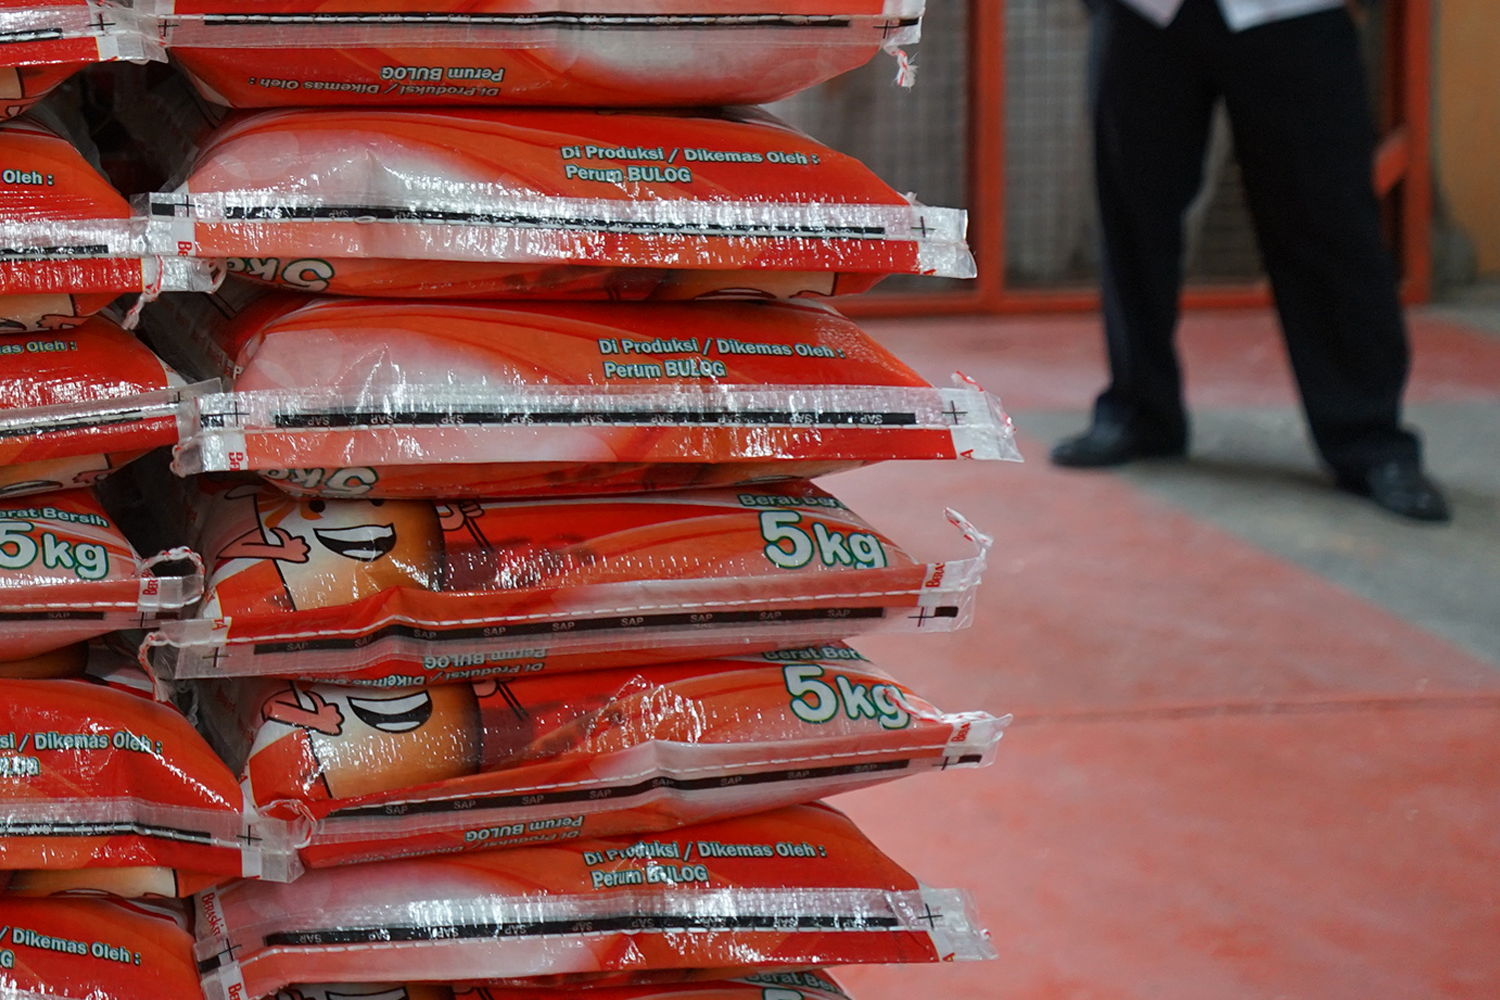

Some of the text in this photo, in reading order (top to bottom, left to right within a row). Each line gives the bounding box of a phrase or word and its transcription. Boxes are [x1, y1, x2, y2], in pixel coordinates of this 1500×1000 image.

[381, 67, 505, 80] Perum BULOG
[561, 146, 582, 159] Di
[586, 146, 664, 161] Produksi
[684, 148, 763, 164] Dikemas
[766, 151, 808, 165] Oleh
[566, 165, 692, 182] Perum BULOG
[26, 339, 67, 353] Oleh
[599, 339, 619, 354] Di
[622, 340, 699, 356] Produksi
[717, 339, 792, 357] Dikemas
[795, 343, 833, 358] Oleh
[604, 361, 727, 379] Perum BULOG
[42, 507, 110, 528] Bersih
[760, 510, 888, 569] 5kg
[465, 815, 583, 842] Perum BULOG
[12, 929, 88, 956] Dikemas
[91, 943, 130, 964] Oleh
